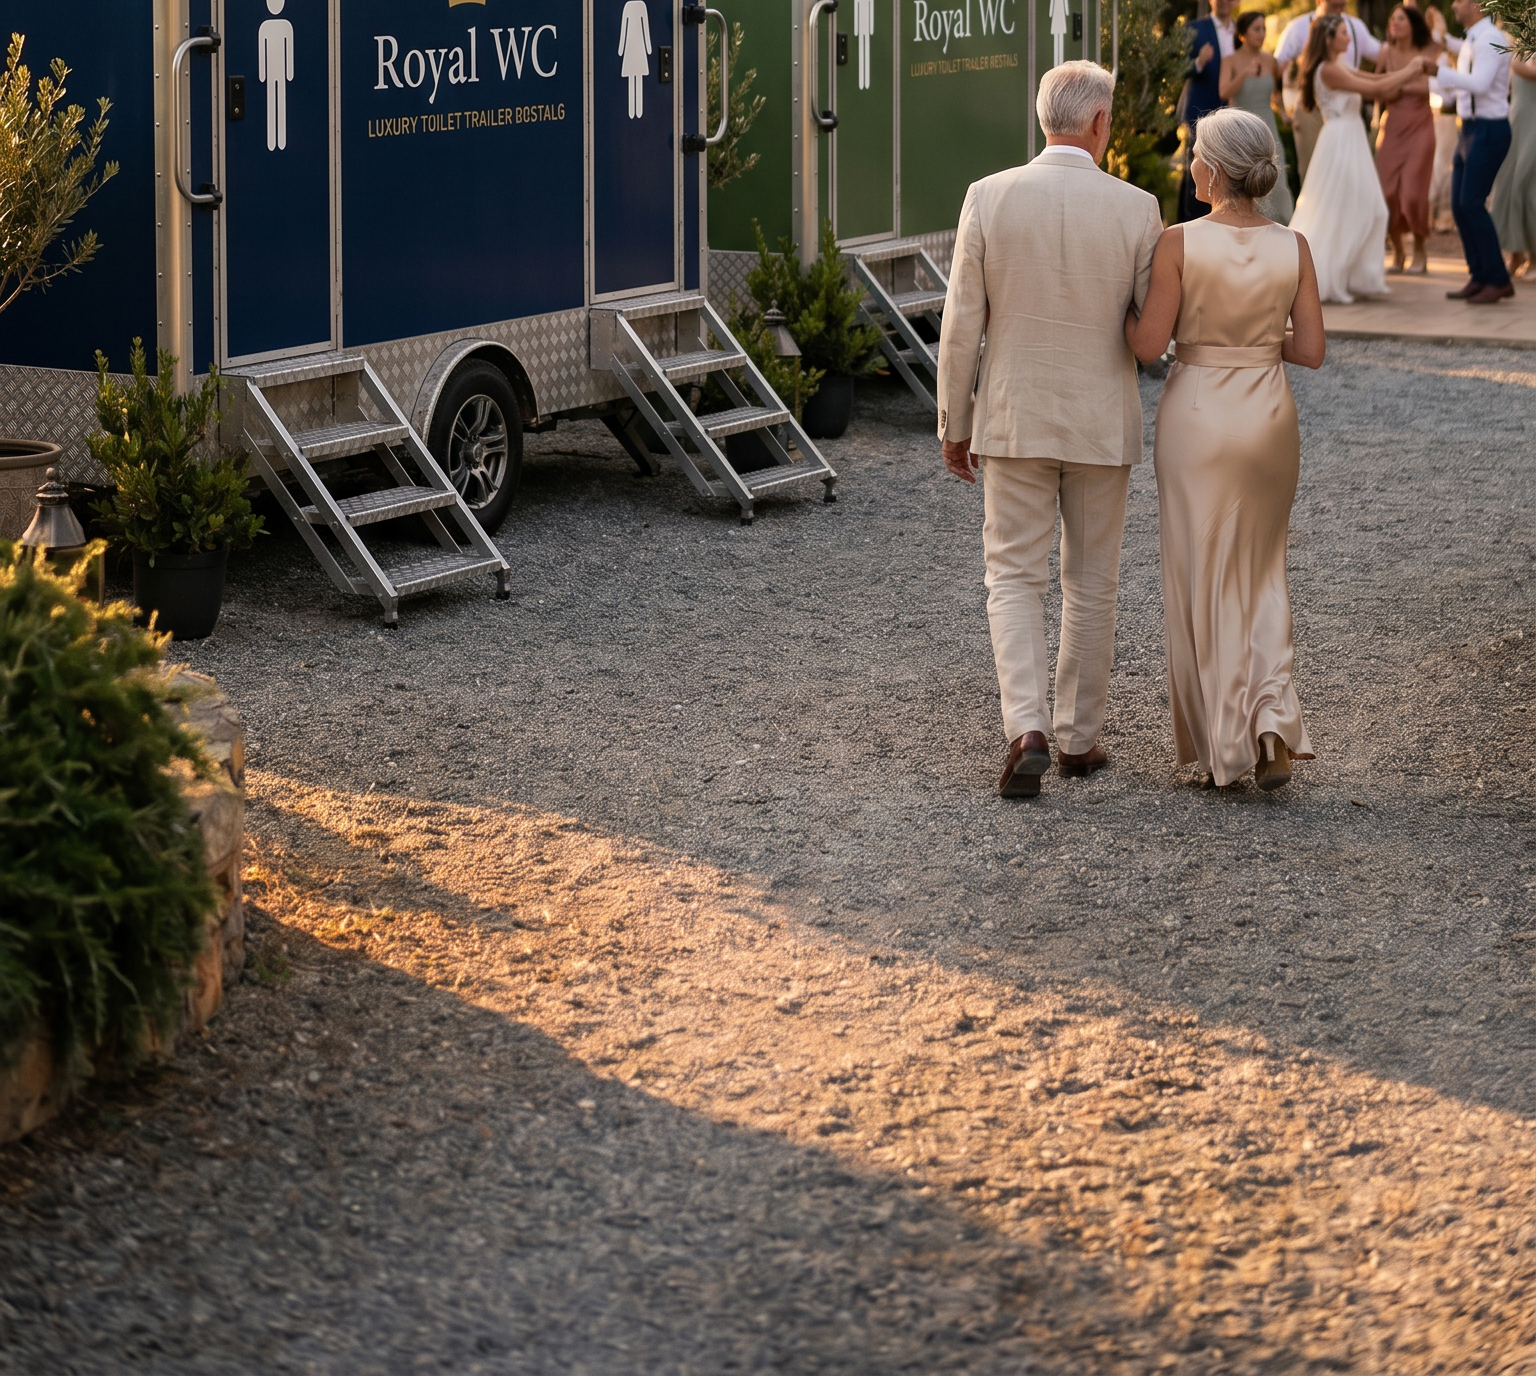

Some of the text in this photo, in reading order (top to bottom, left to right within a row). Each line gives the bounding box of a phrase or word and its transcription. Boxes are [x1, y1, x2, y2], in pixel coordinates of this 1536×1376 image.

[373, 24, 558, 104] Royal WC
[368, 115, 418, 138] LUXURY
[420, 112, 462, 133] TOILET
[463, 107, 513, 129] TRAILER
